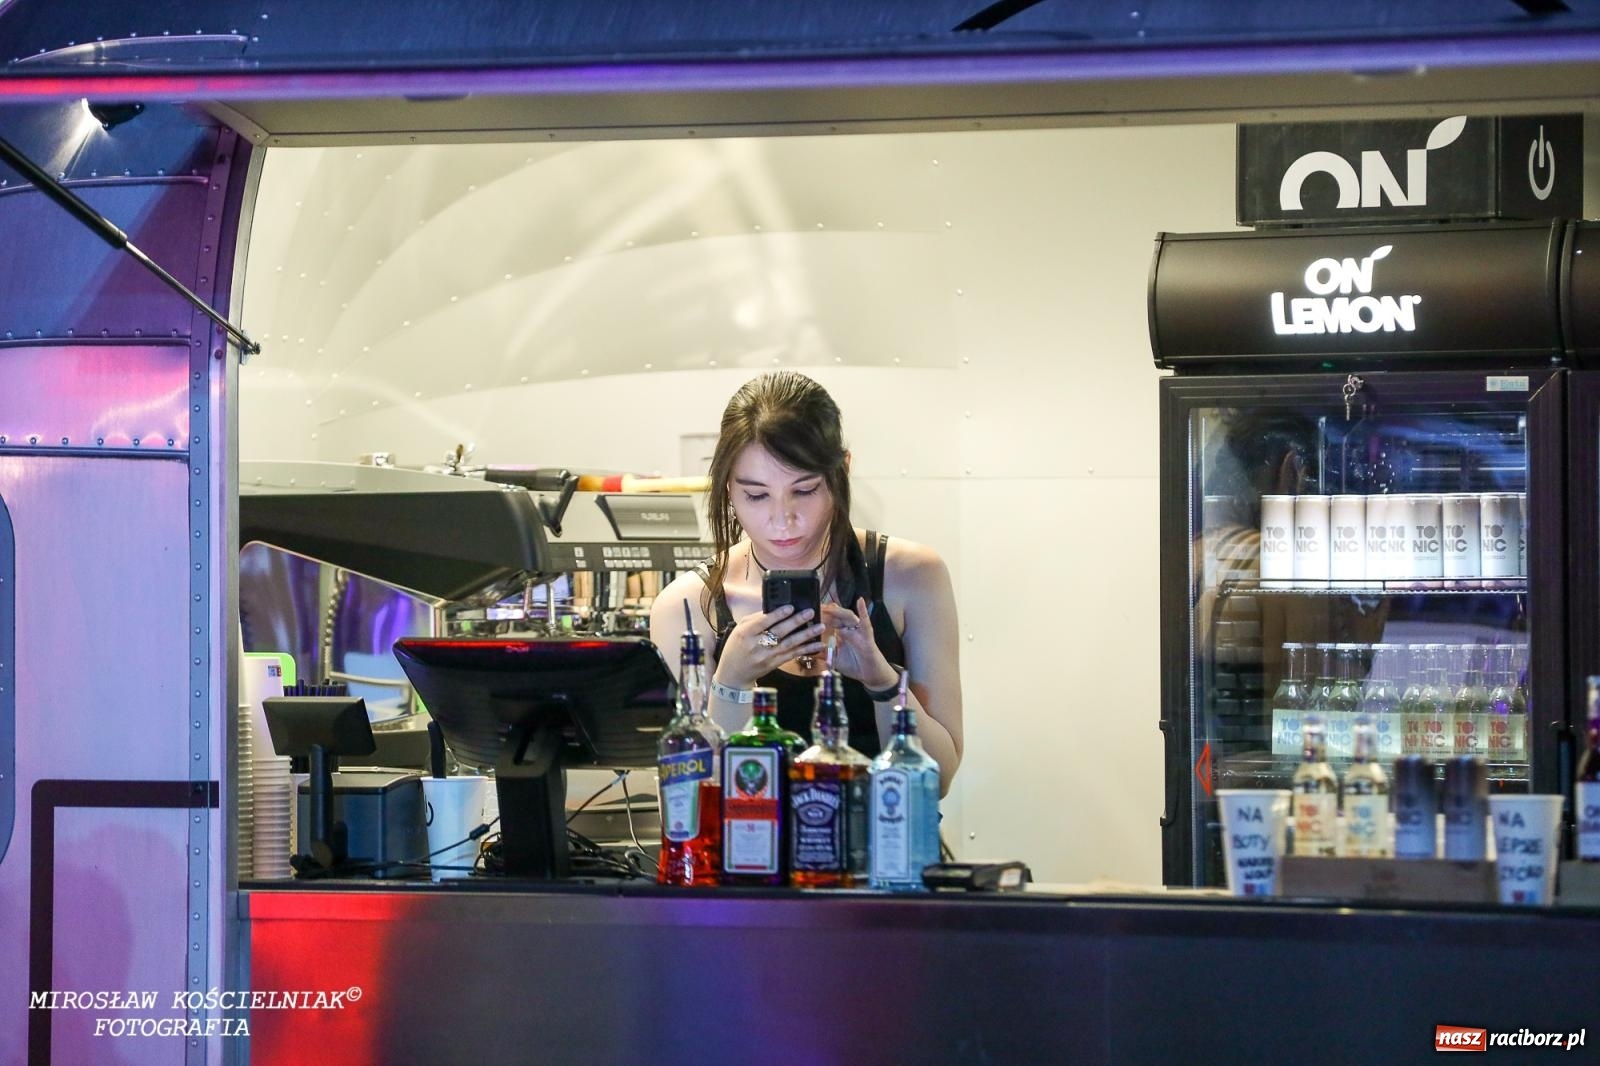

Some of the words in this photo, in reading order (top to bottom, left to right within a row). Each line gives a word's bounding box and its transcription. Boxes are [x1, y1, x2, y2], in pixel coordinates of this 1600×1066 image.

[1279, 149, 1428, 211] ON
[1303, 257, 1374, 296] ON
[1270, 292, 1417, 336] LEMON
[1412, 539, 1440, 553] NIC
[1444, 539, 1468, 553] NIC
[1482, 538, 1507, 553] NIC
